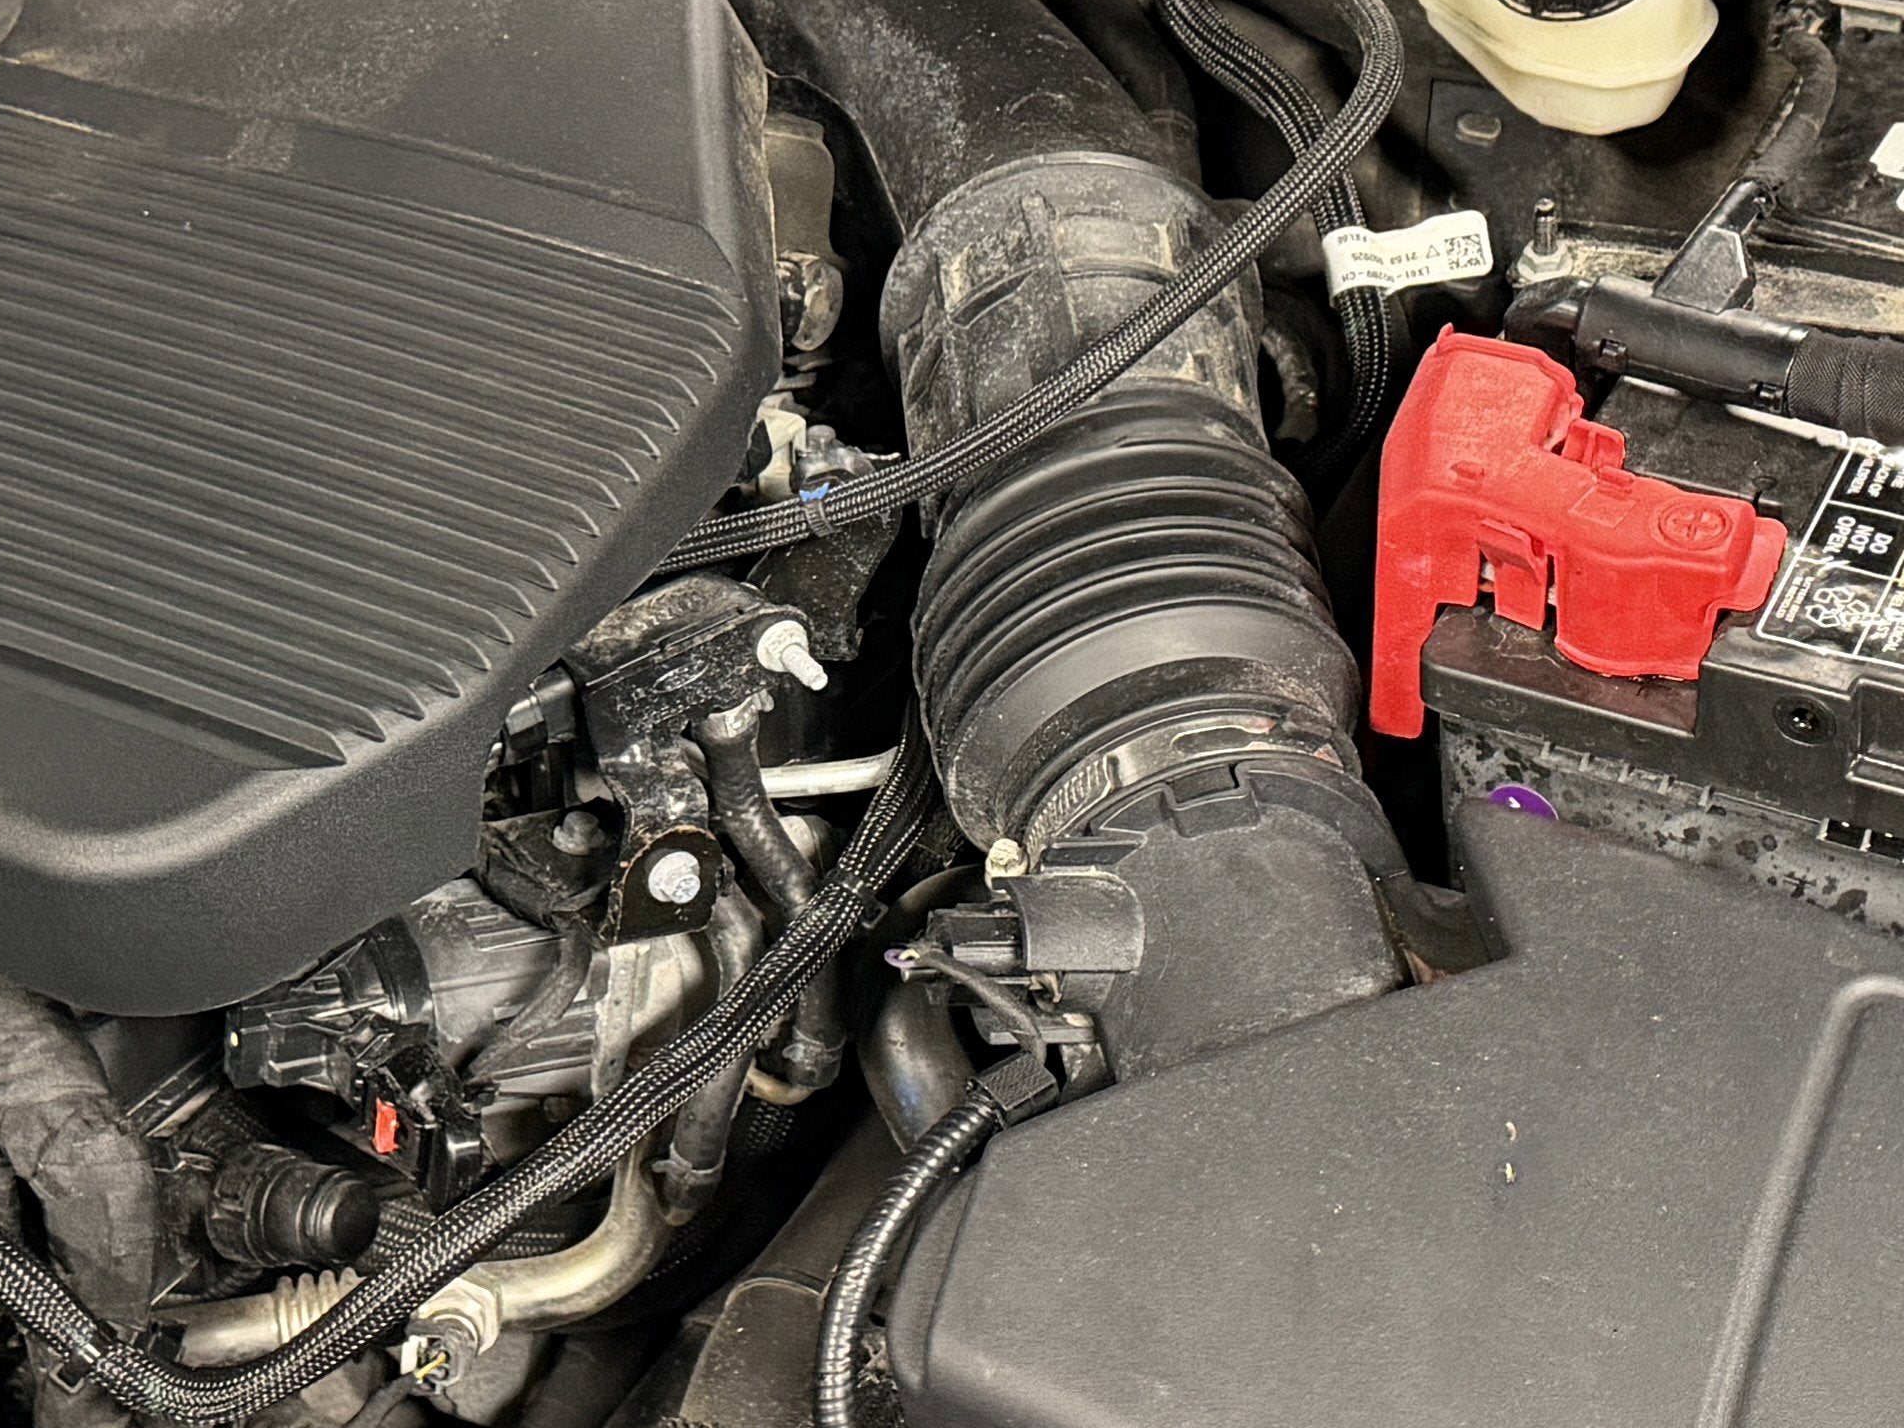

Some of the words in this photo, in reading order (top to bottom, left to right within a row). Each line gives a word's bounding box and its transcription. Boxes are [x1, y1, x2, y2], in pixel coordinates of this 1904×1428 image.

[1868, 483, 1883, 498] OF
[1847, 524, 1875, 554] NOT
[1869, 532, 1893, 554] DO
